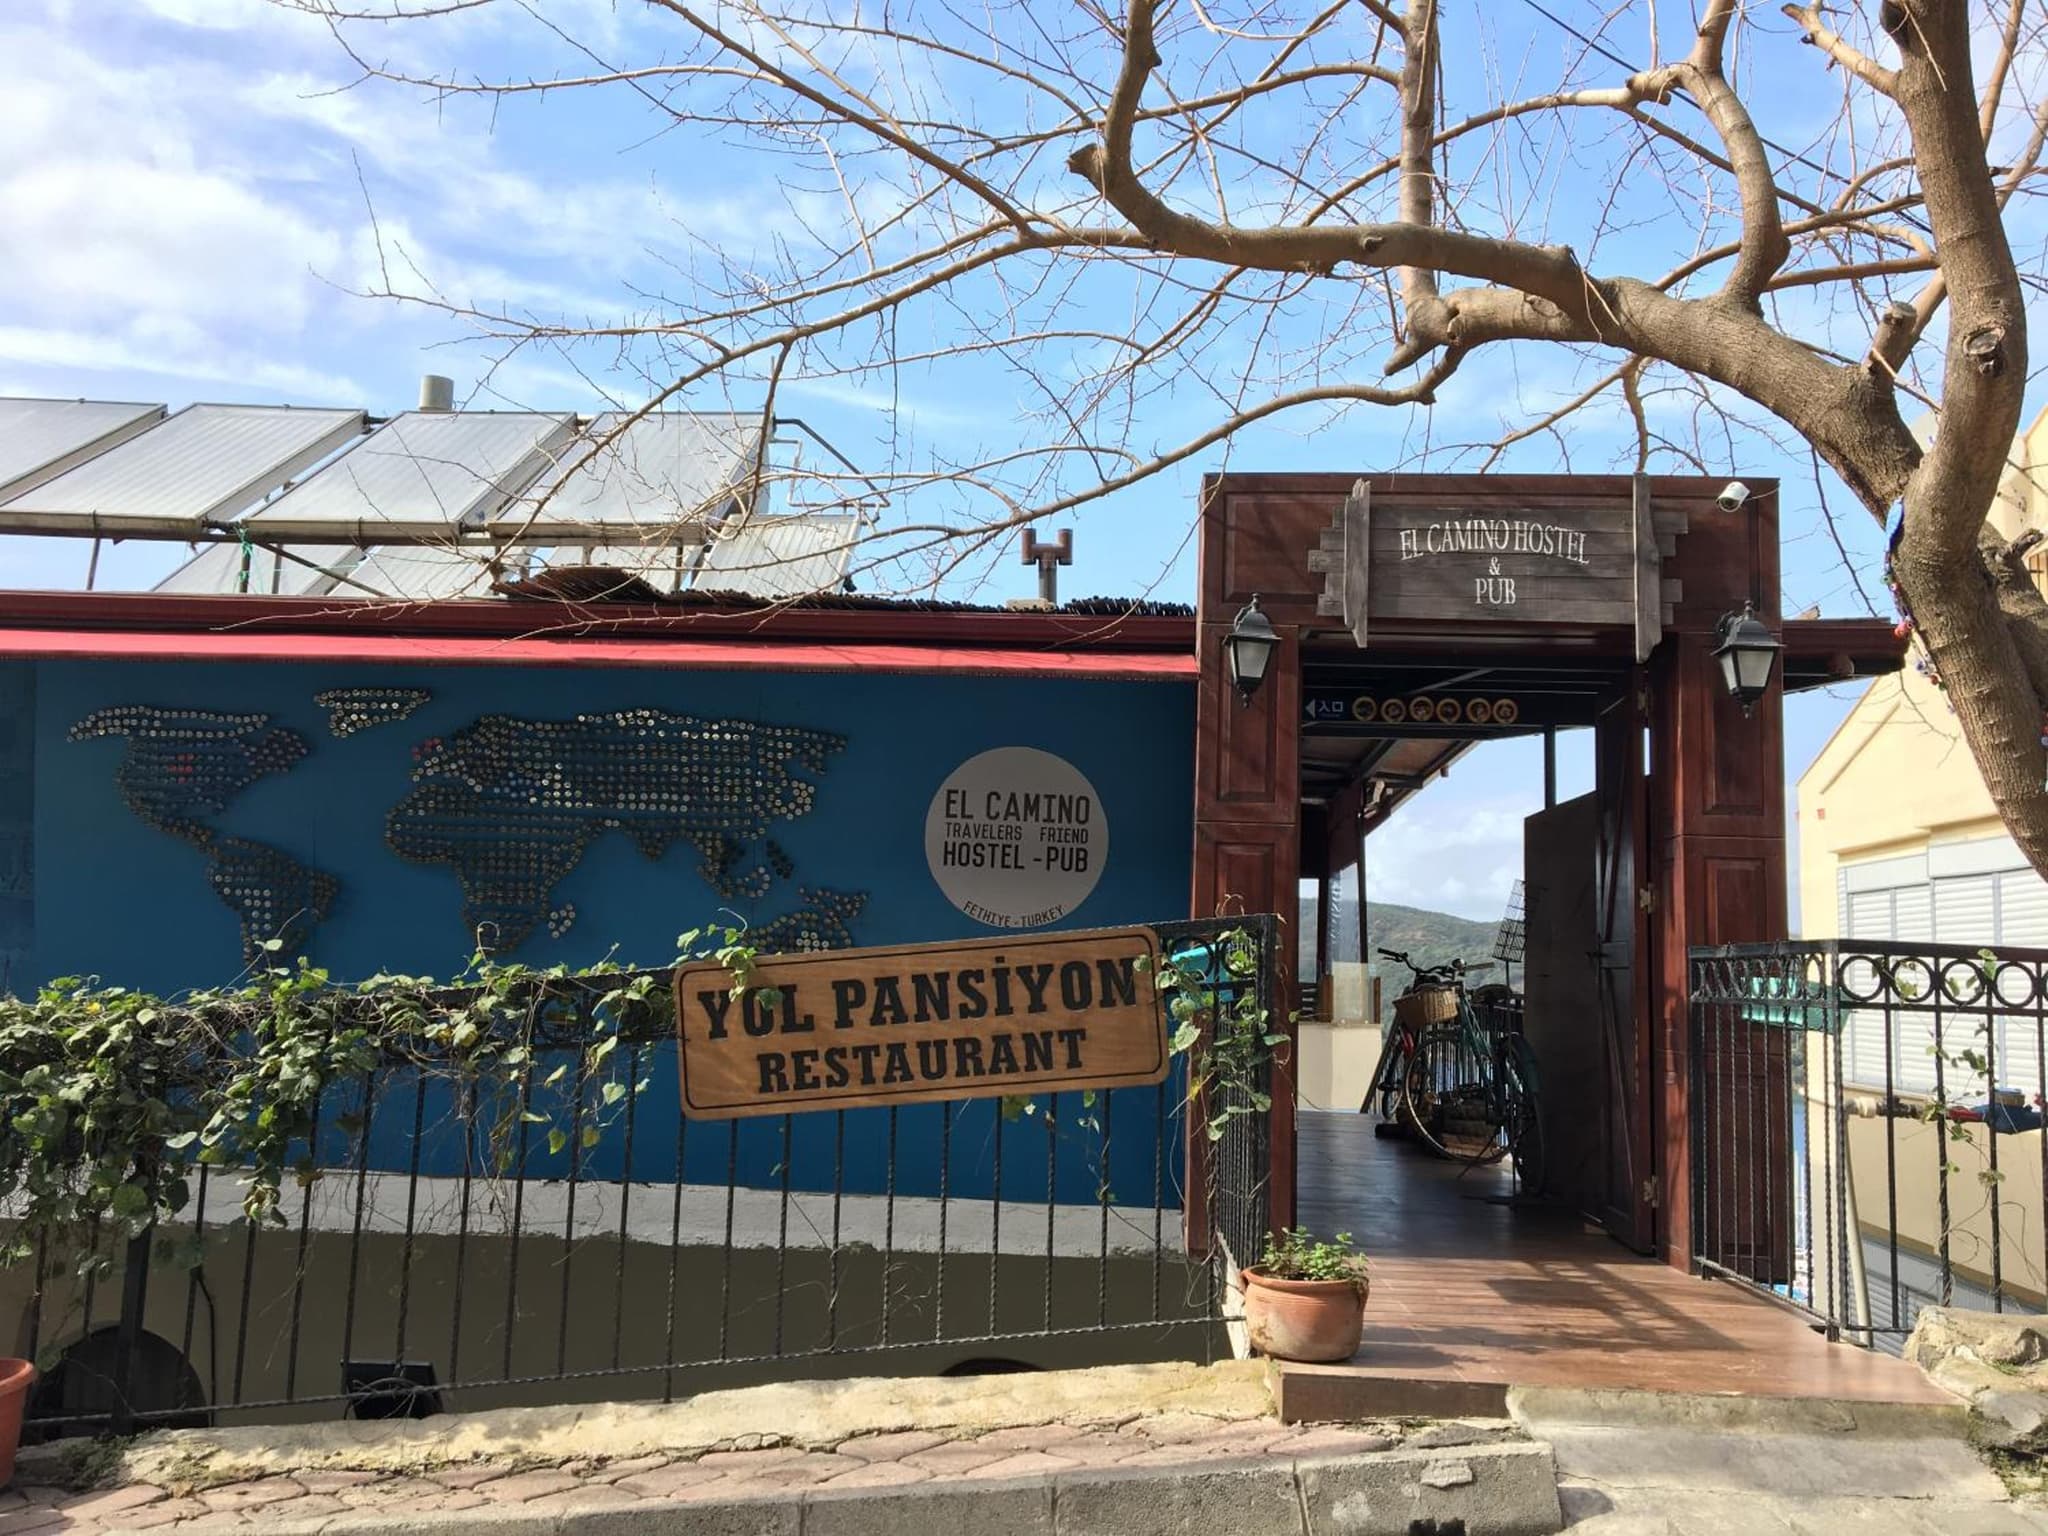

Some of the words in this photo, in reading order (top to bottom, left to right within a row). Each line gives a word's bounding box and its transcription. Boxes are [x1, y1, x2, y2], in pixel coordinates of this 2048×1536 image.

[1400, 529, 1424, 560] EL
[1427, 519, 1510, 553] CAMINO
[1514, 520, 1590, 564] HOSTEL
[1488, 556, 1501, 576] &
[1475, 577, 1517, 605] PUB
[1318, 700, 1344, 713] 入口
[945, 788, 974, 819] EL
[986, 791, 1090, 825] CAMINO
[945, 822, 1023, 841] TRAVELERS
[1039, 826, 1089, 844] FRIEND
[943, 840, 1025, 870] HOSTEL
[697, 983, 816, 1040] YOL
[831, 955, 1139, 1030] PANSİYON
[757, 1028, 1087, 1094] RESTAURANT
